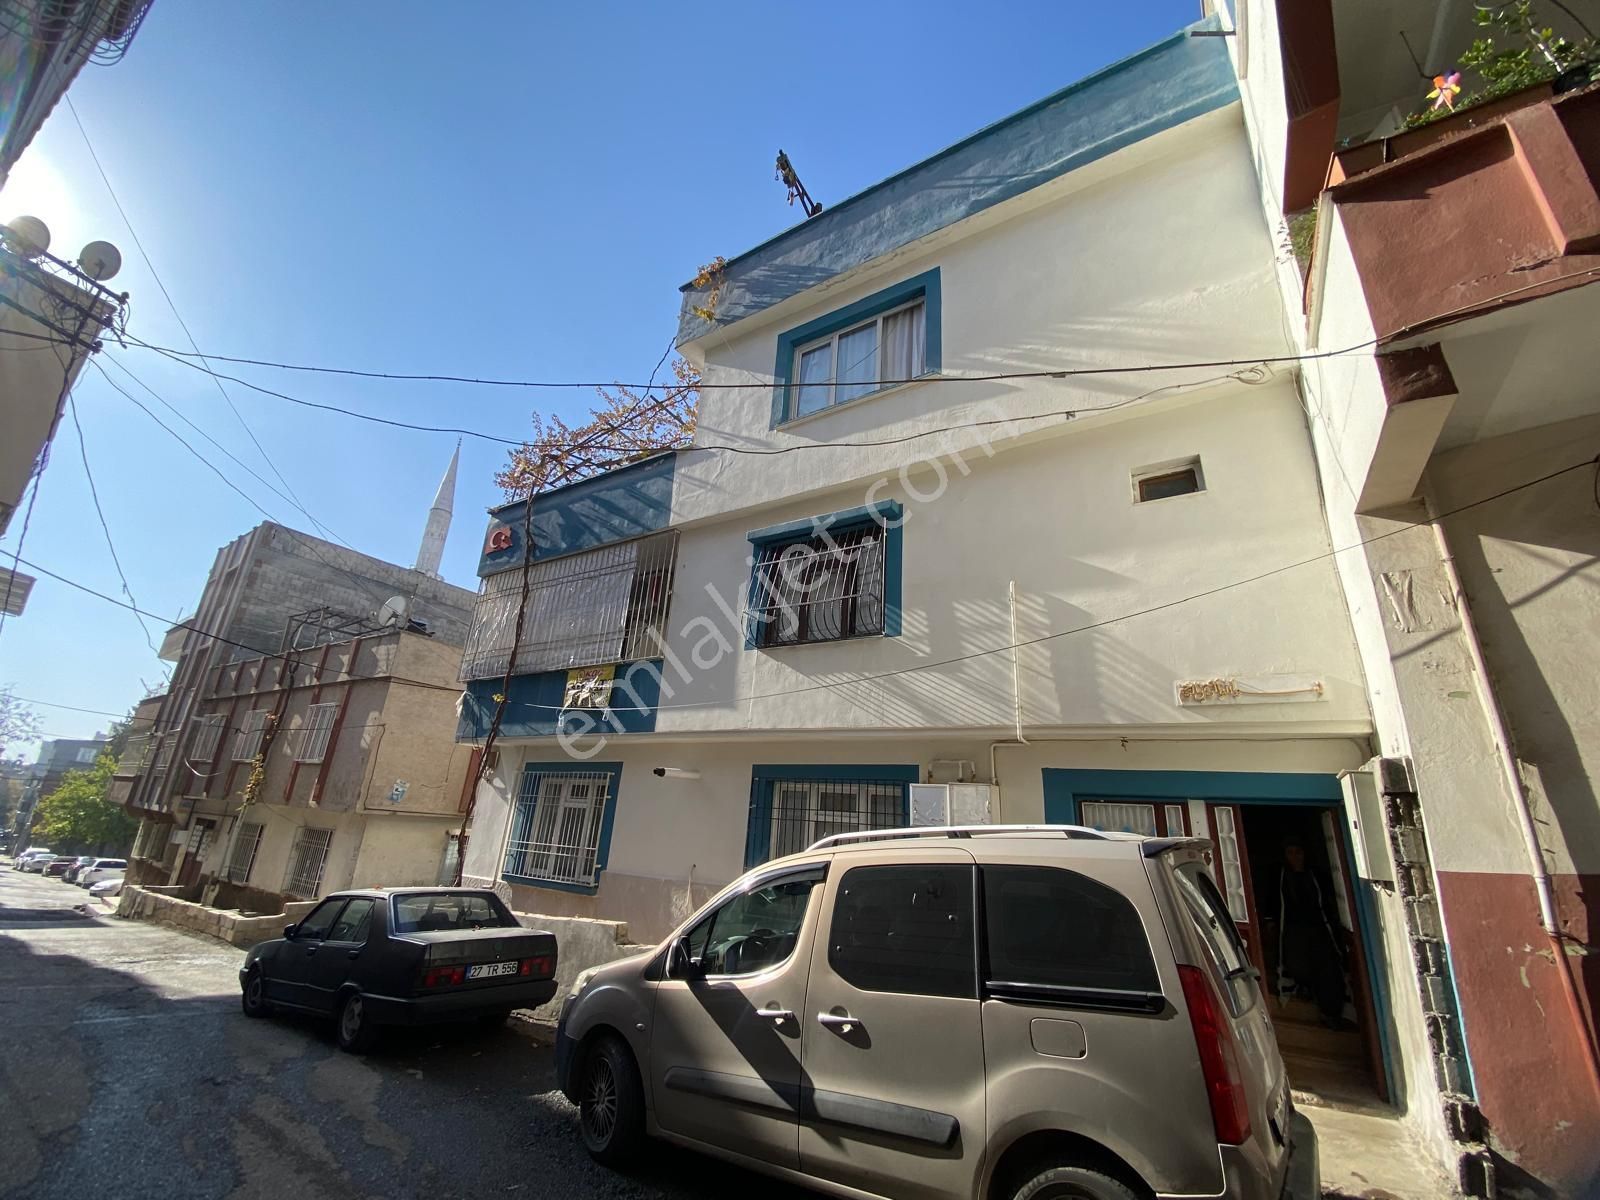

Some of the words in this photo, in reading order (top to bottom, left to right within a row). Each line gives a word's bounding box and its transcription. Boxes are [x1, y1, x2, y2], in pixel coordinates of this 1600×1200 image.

[471, 966, 483, 977] 27
[487, 964, 499, 975] TR
[502, 962, 517, 974] 556
